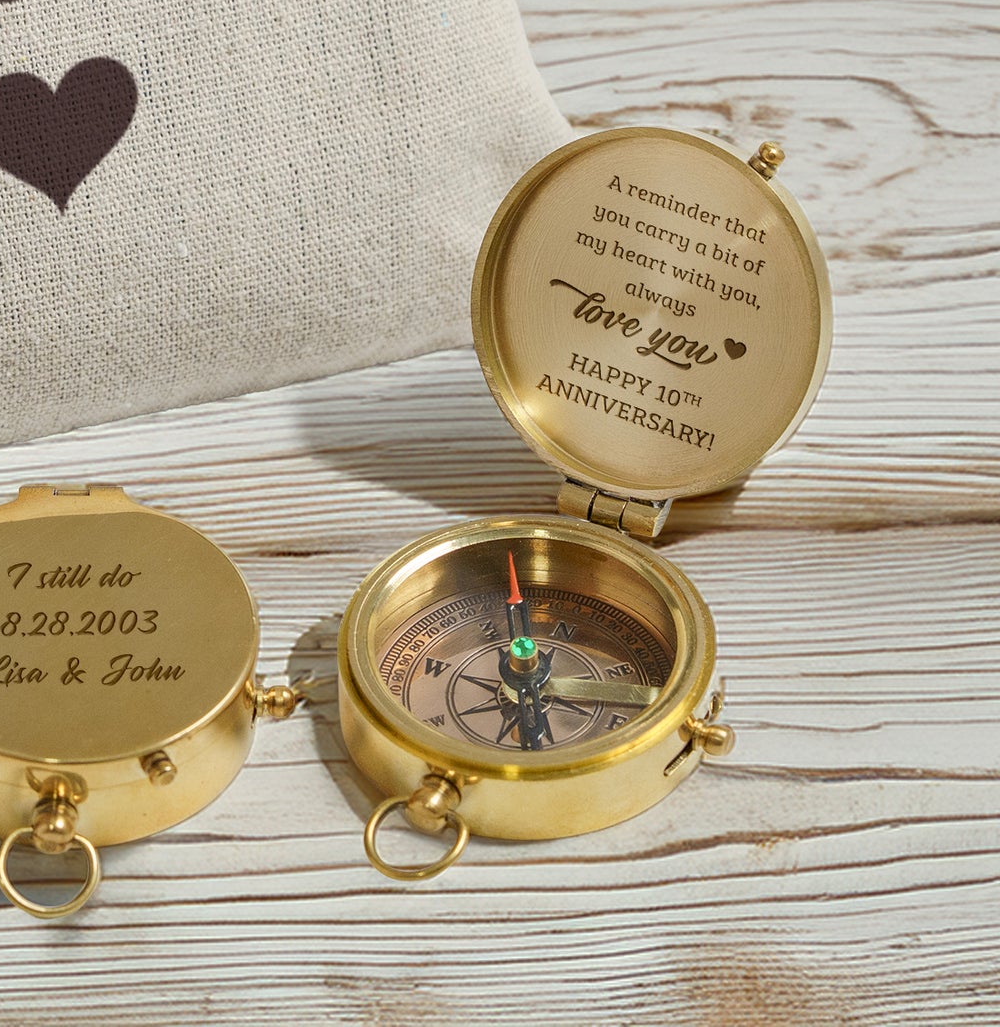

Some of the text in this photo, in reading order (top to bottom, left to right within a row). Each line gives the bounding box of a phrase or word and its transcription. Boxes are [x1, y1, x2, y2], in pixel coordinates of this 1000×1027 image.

[607, 175, 767, 245] A reminder that
[592, 204, 767, 276] you carry a bit of
[576, 231, 761, 311] my heart with you,
[625, 282, 697, 317] always
[636, 327, 718, 371] you
[568, 352, 652, 396] HAPPY
[535, 373, 716, 452] ANNIVERSARY!
[7, 562, 142, 590] I still do
[0, 609, 159, 637] 8.28.2003
[398, 653, 414, 667] 90
[409, 639, 426, 653] 80
[422, 626, 440, 639] 70
[440, 616, 457, 629] 60
[459, 606, 476, 620] 50
[549, 620, 578, 641] N
[60, 656, 87, 686] &
[101, 653, 186, 687] John
[424, 657, 452, 678] W
[604, 661, 635, 678] NE
